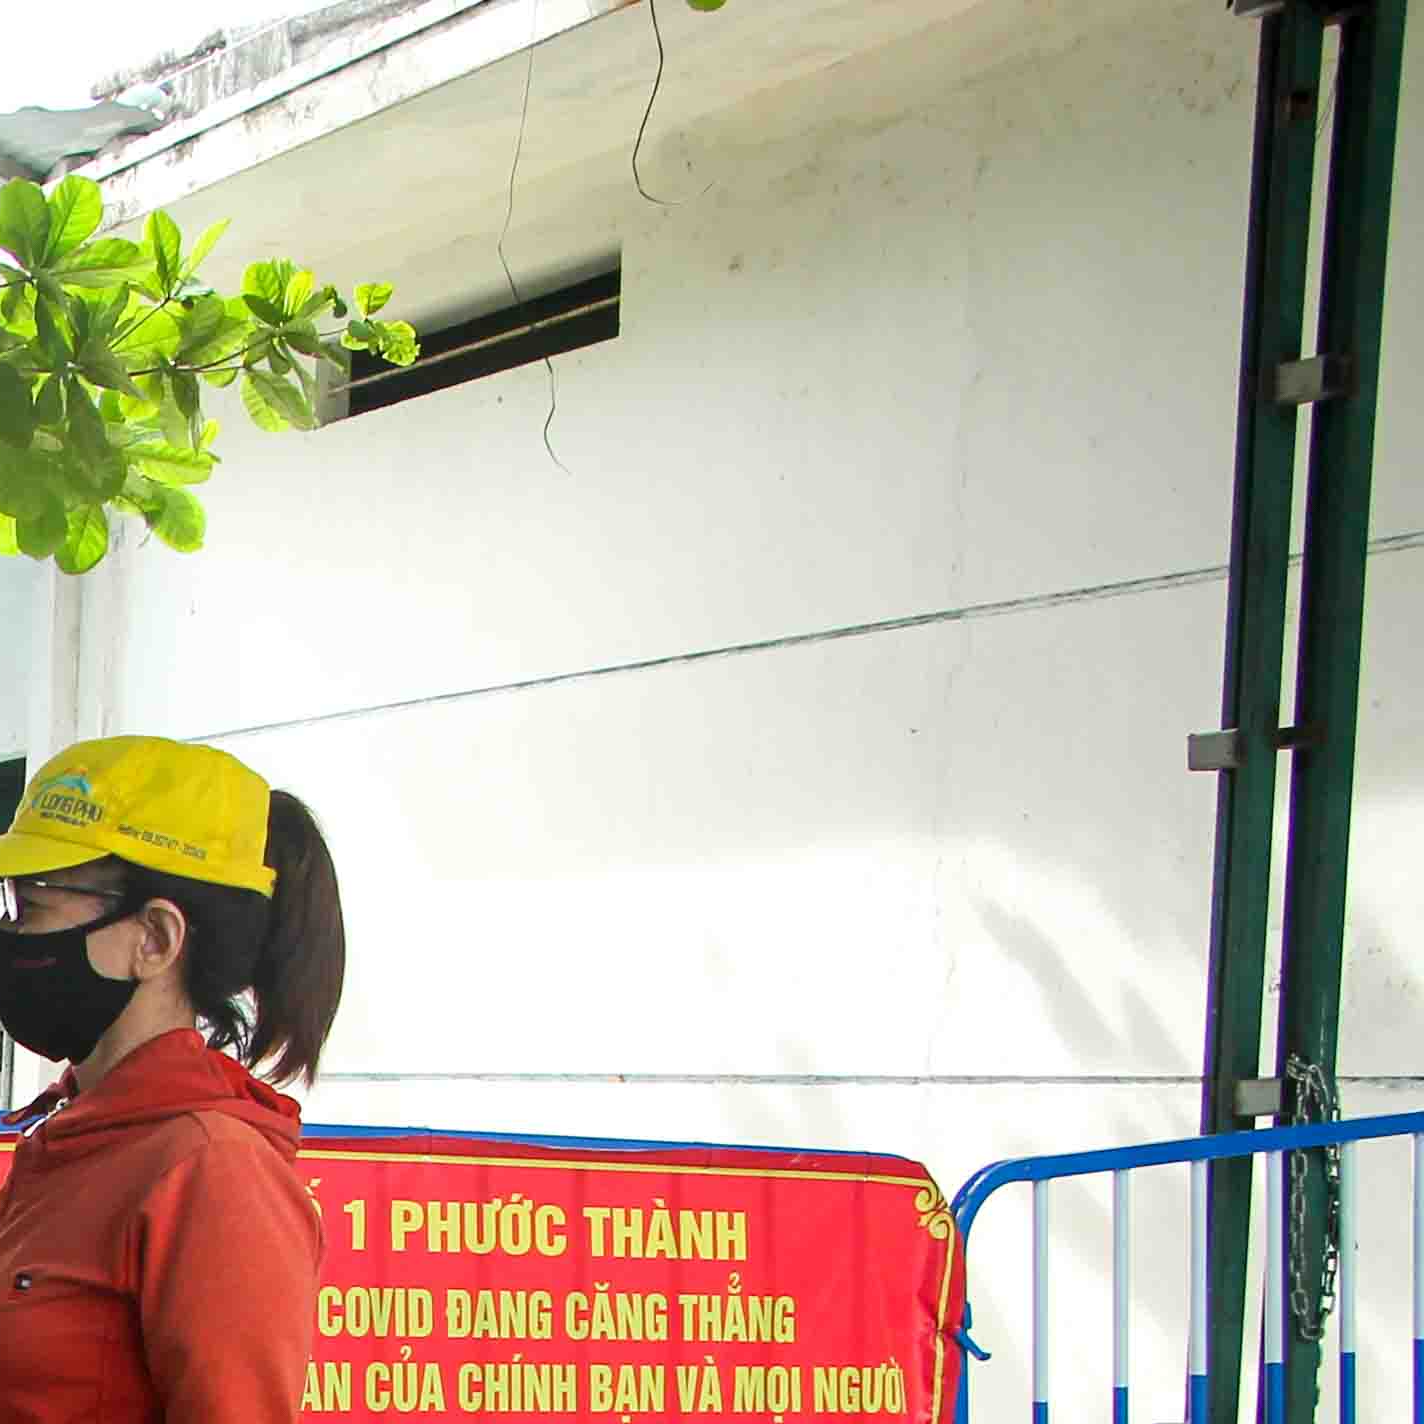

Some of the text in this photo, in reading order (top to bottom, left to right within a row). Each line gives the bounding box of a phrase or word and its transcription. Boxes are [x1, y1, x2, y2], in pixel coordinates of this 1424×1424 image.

[343, 1199, 366, 1250] 1
[390, 1192, 568, 1257] PHƯỚC
[582, 1198, 747, 1261] THÀNH
[317, 1271, 795, 1344] COVID ĐANG CĂNG THẲNG
[364, 1344, 446, 1413] CỦA
[458, 1353, 577, 1413] CHÍNH
[589, 1364, 665, 1424] BẠN
[676, 1355, 723, 1413] VÀ
[733, 1365, 802, 1424] MỌI
